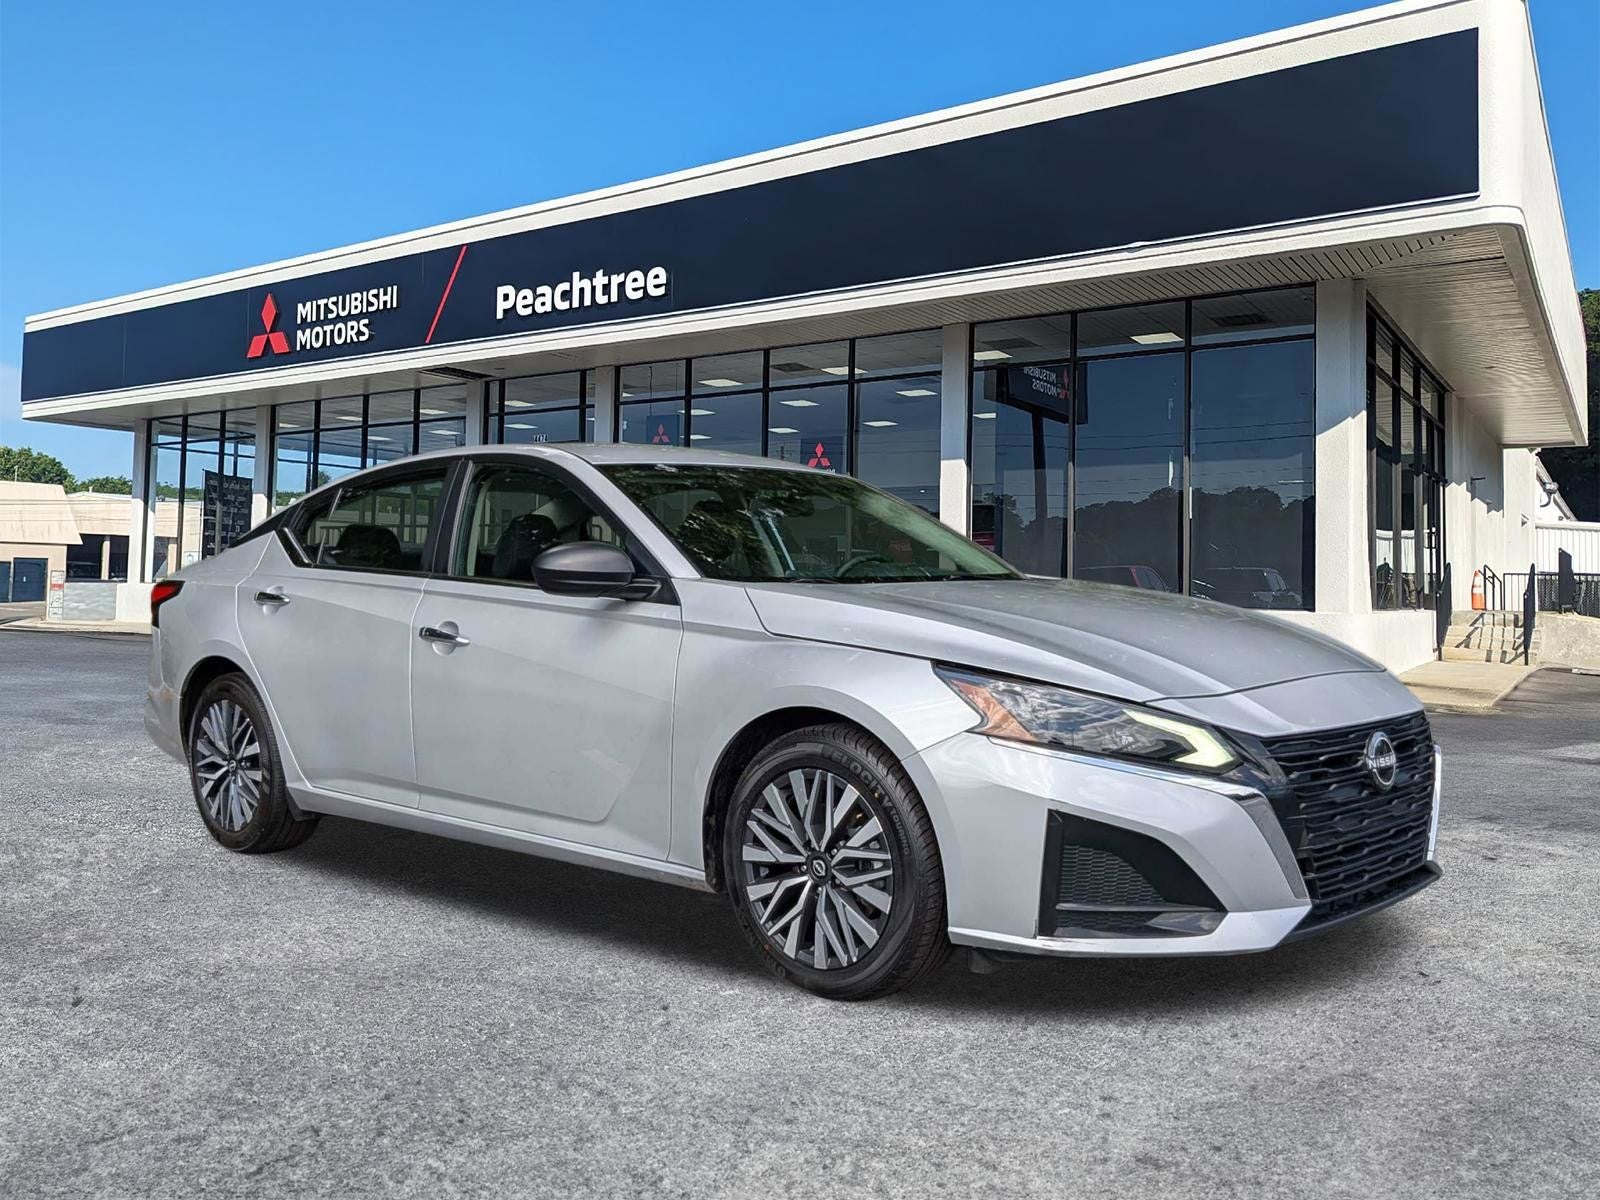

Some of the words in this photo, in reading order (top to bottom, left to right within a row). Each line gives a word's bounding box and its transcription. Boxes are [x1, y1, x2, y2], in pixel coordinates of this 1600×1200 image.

[296, 285, 398, 325] MITSUBISHI
[496, 266, 667, 320] Peachtree
[296, 318, 370, 351] MOTORS
